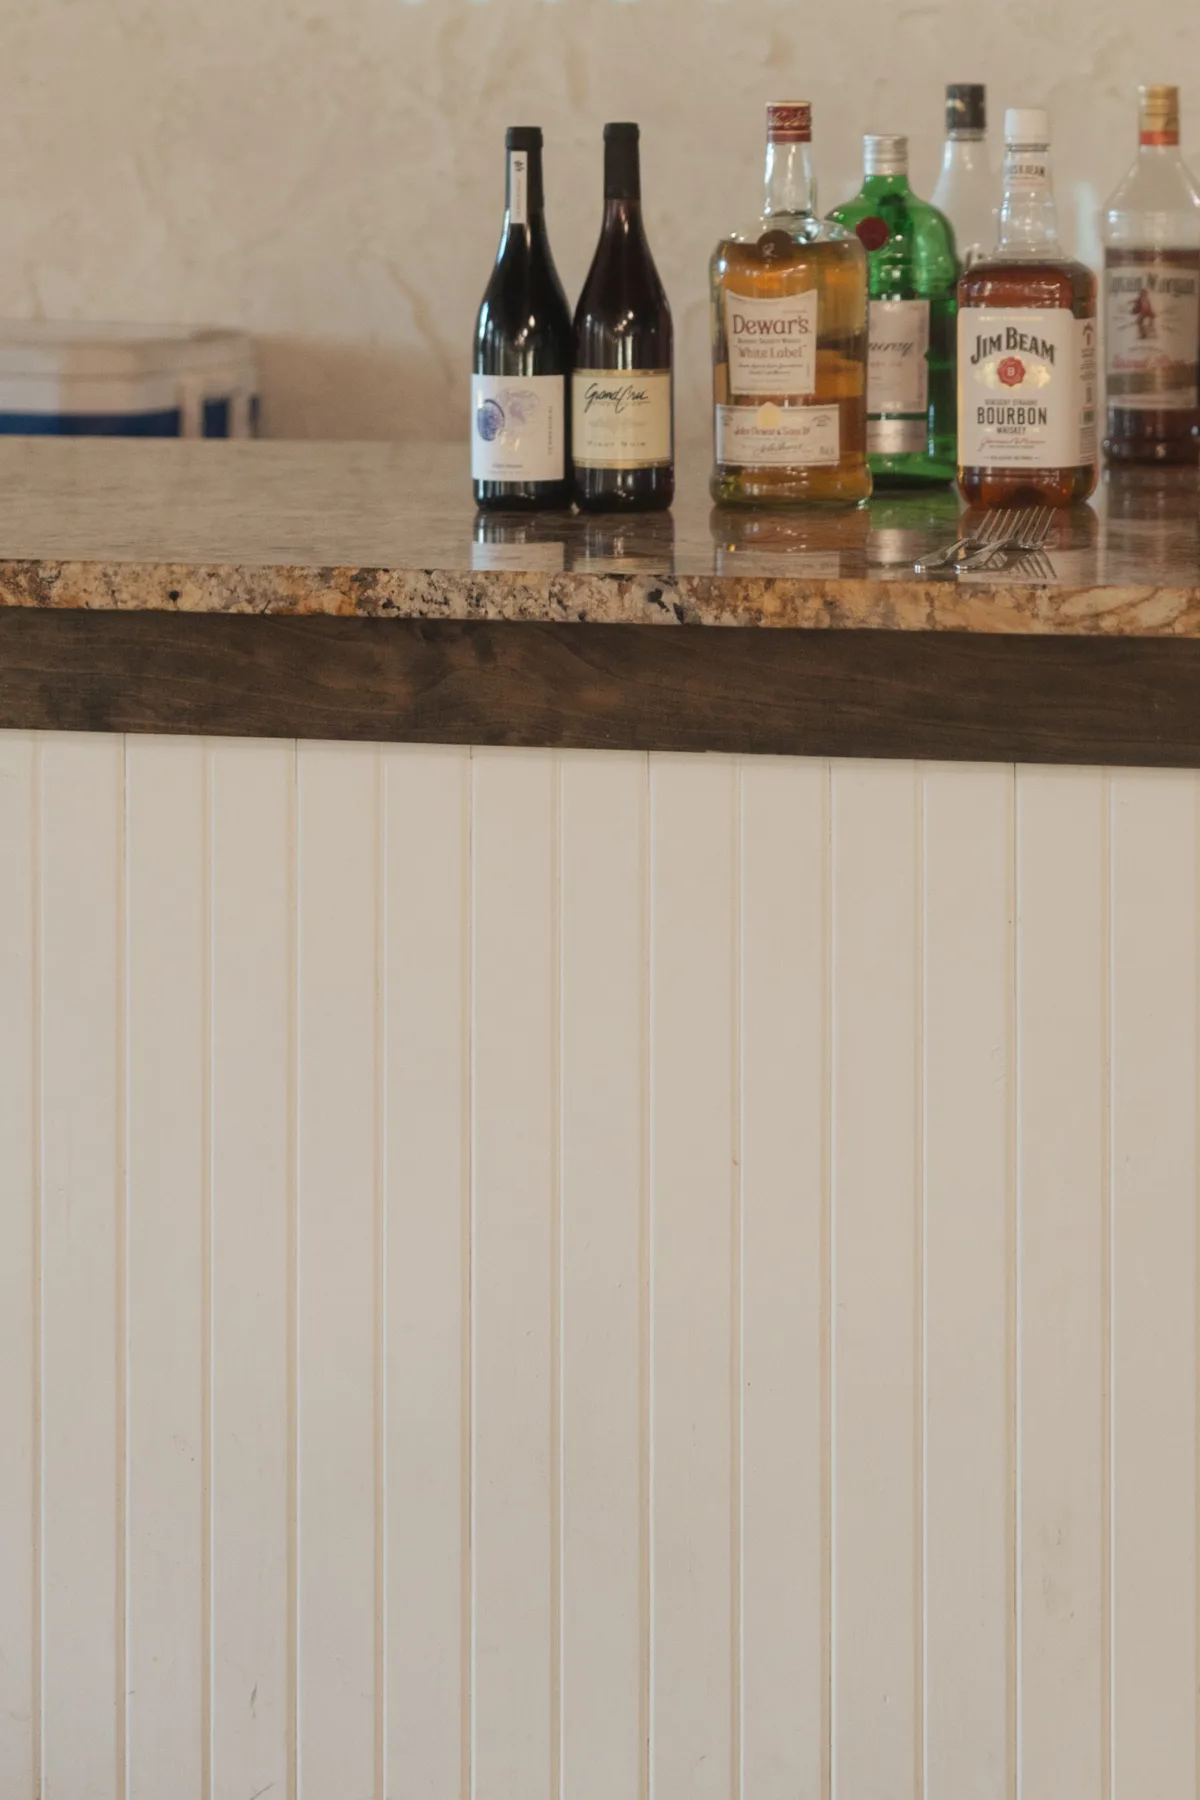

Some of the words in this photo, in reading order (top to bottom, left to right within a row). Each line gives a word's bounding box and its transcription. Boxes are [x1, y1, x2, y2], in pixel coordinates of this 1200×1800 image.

[732, 313, 810, 335] Dewar's
[969, 333, 1003, 366] JIM
[1005, 326, 1057, 367] BEAM
[976, 406, 1048, 426] BOURBON
[996, 426, 1027, 436] WHISKEY
